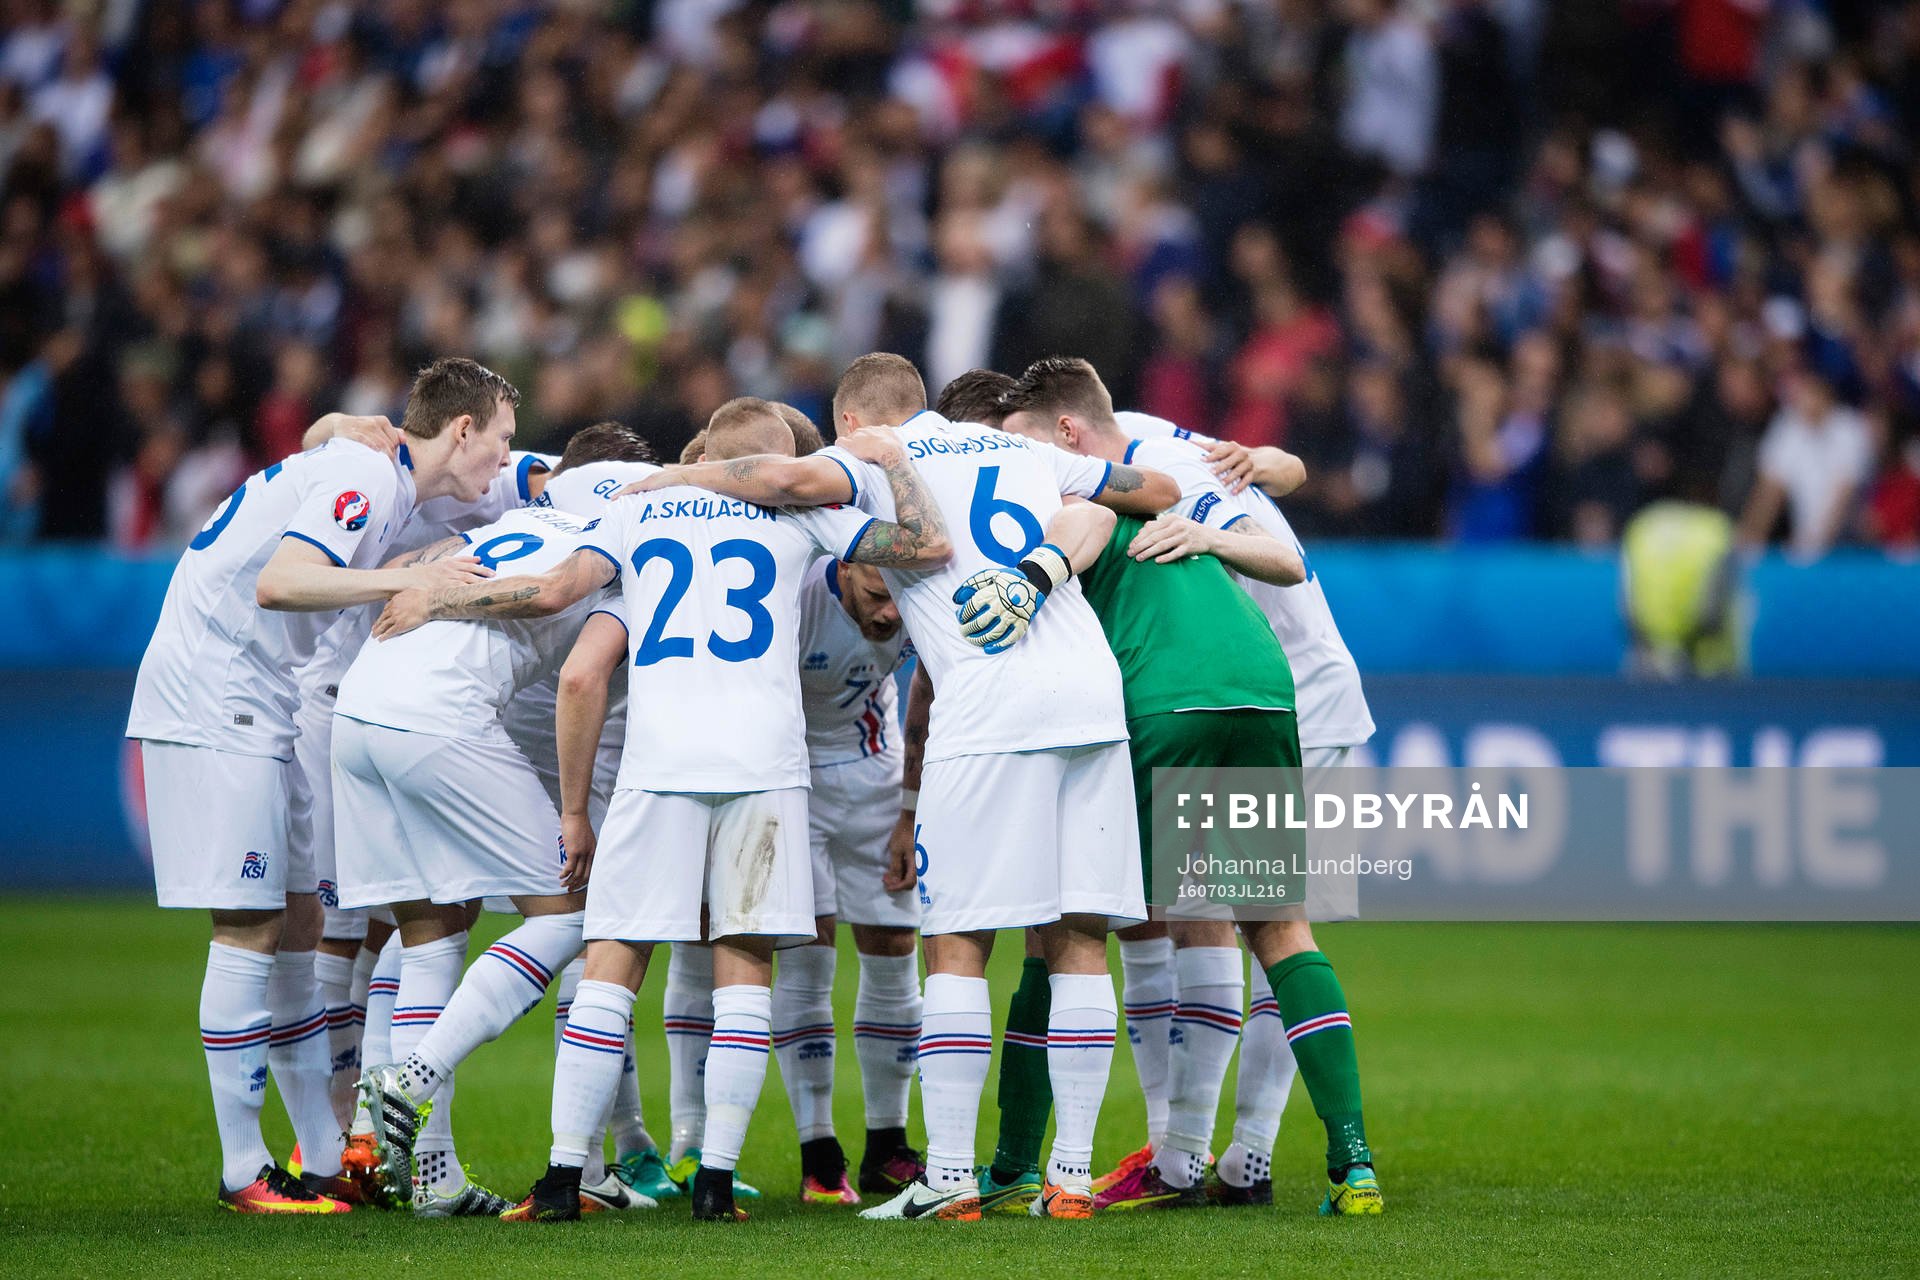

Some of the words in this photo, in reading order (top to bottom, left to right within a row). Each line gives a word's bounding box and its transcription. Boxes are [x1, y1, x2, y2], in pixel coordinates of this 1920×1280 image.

[970, 466, 1045, 569] 6
[631, 538, 777, 666] 23
[1600, 725, 1886, 886] THE
